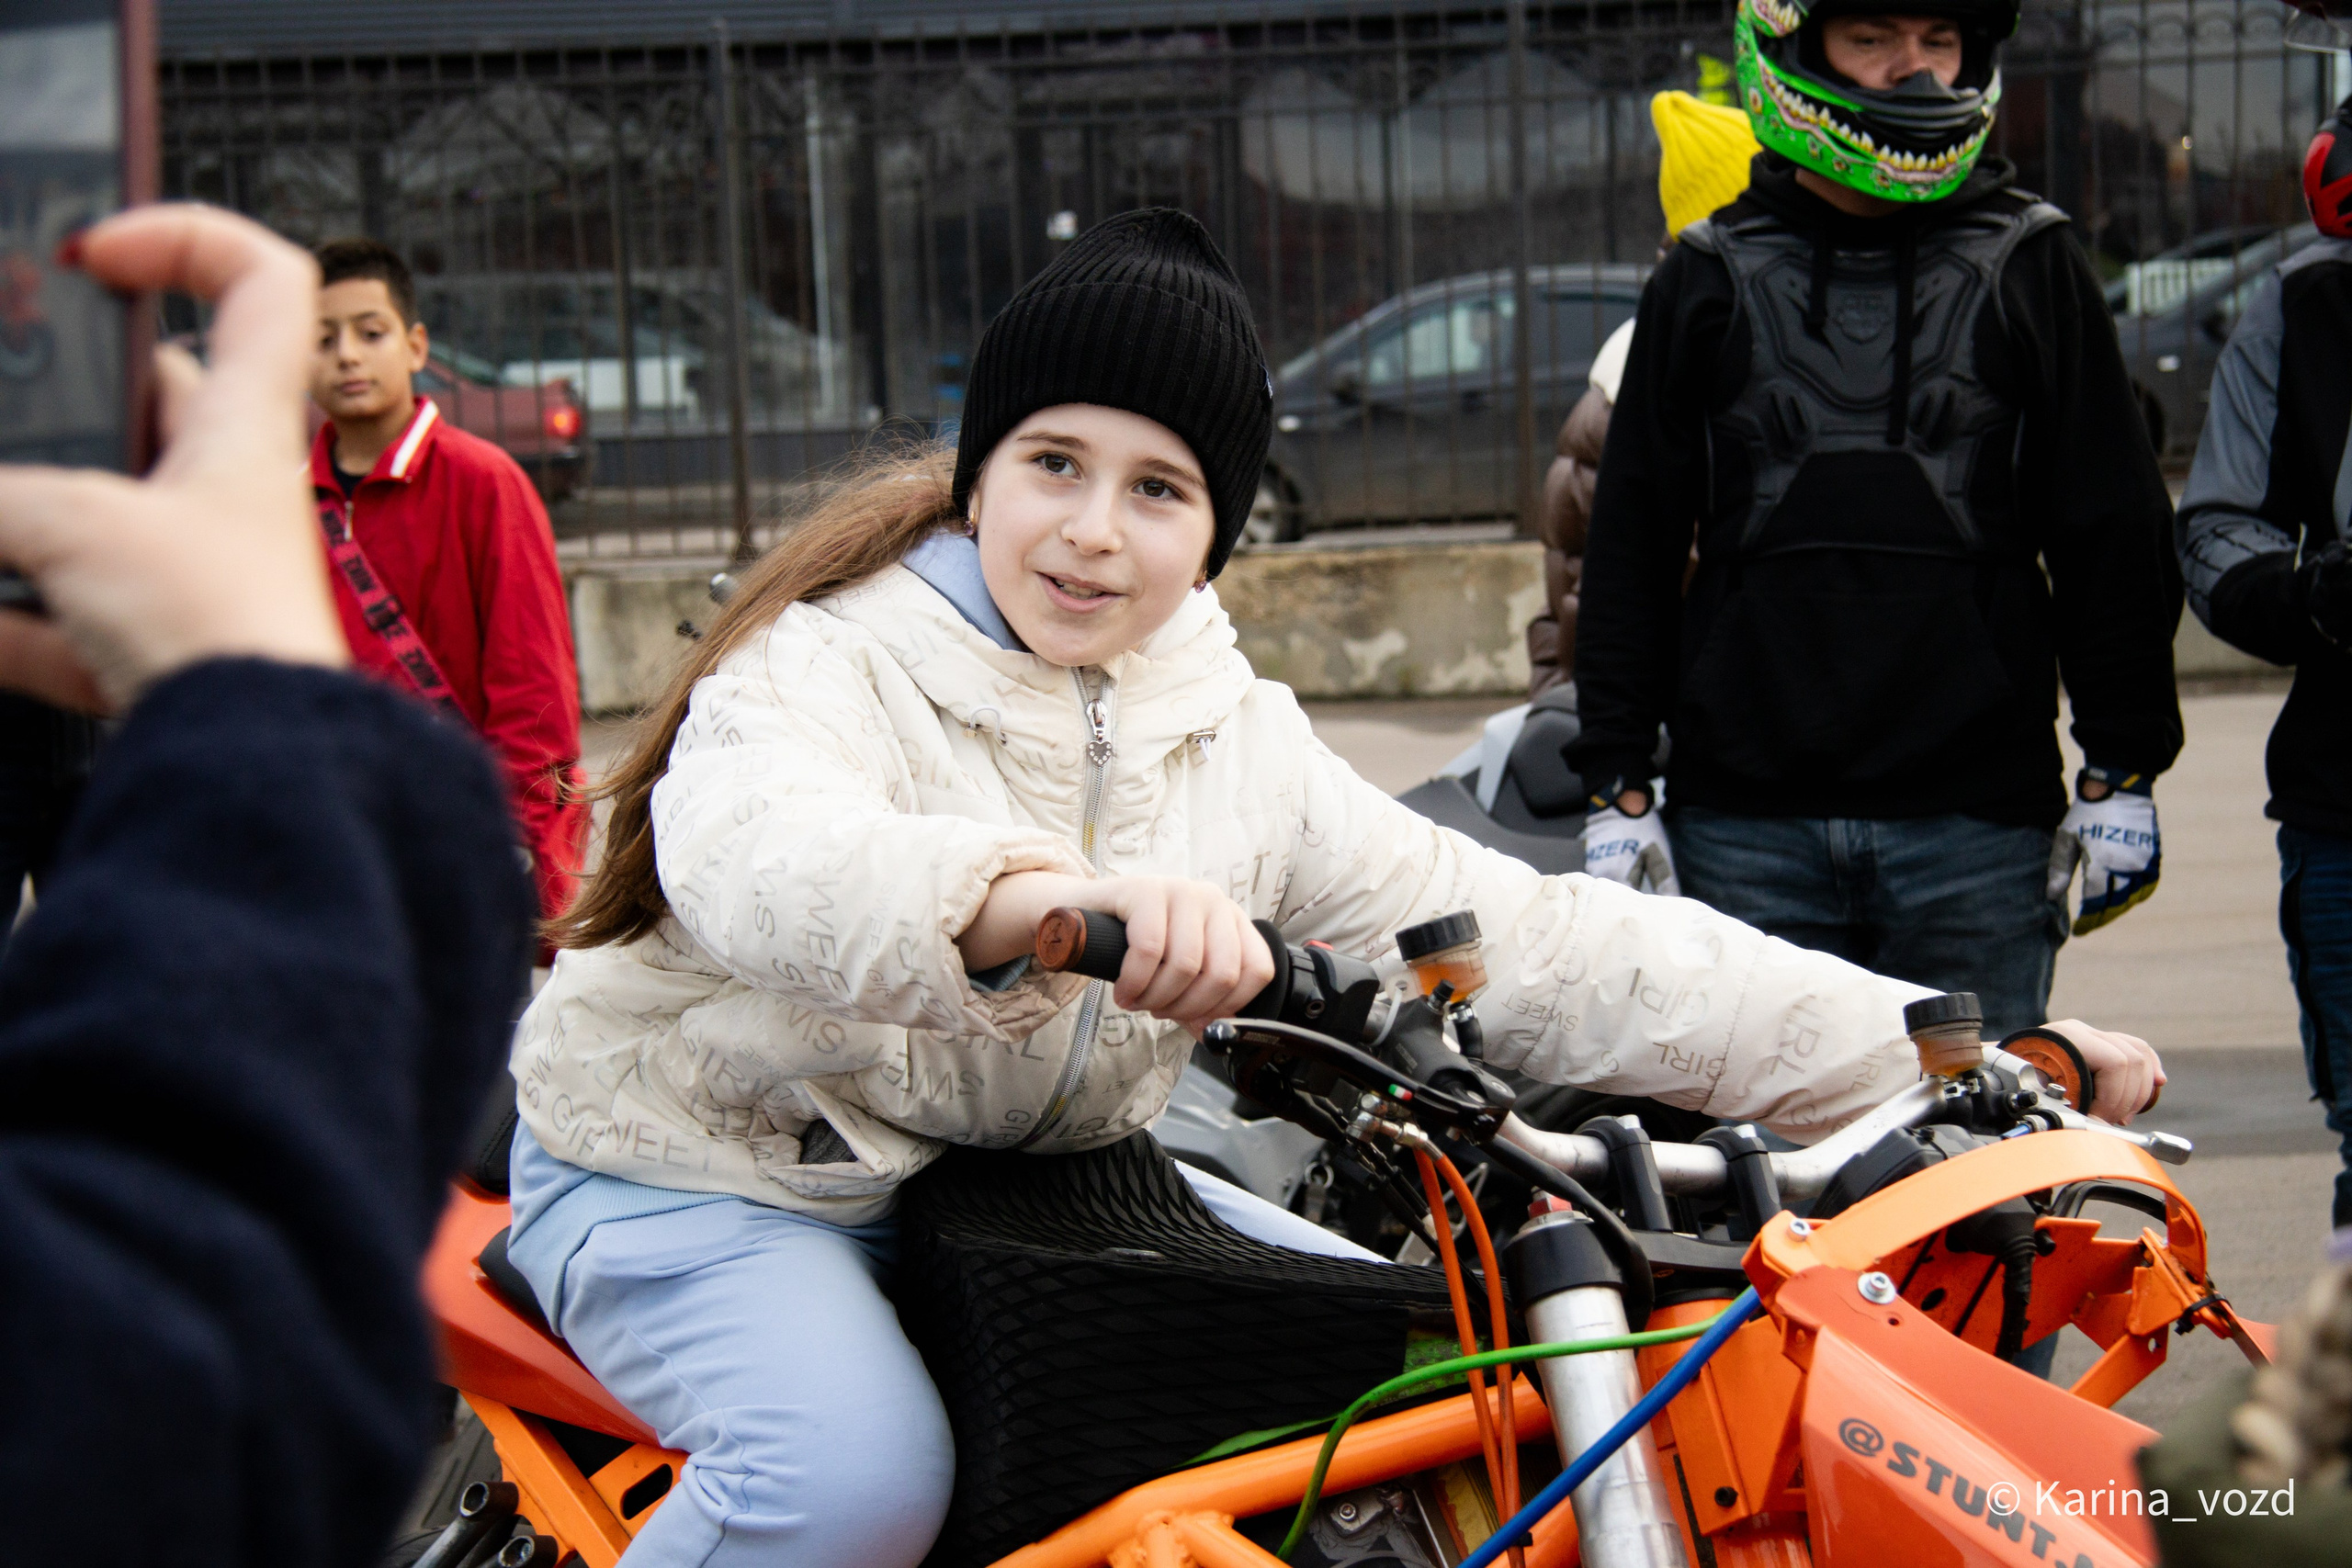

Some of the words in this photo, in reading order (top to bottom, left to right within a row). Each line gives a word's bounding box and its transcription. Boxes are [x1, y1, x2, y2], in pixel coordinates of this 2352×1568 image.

[2078, 823, 2153, 847] HIZER
[1501, 992, 1579, 1032] SWEET
[1653, 1042, 1728, 1080] GIRL
